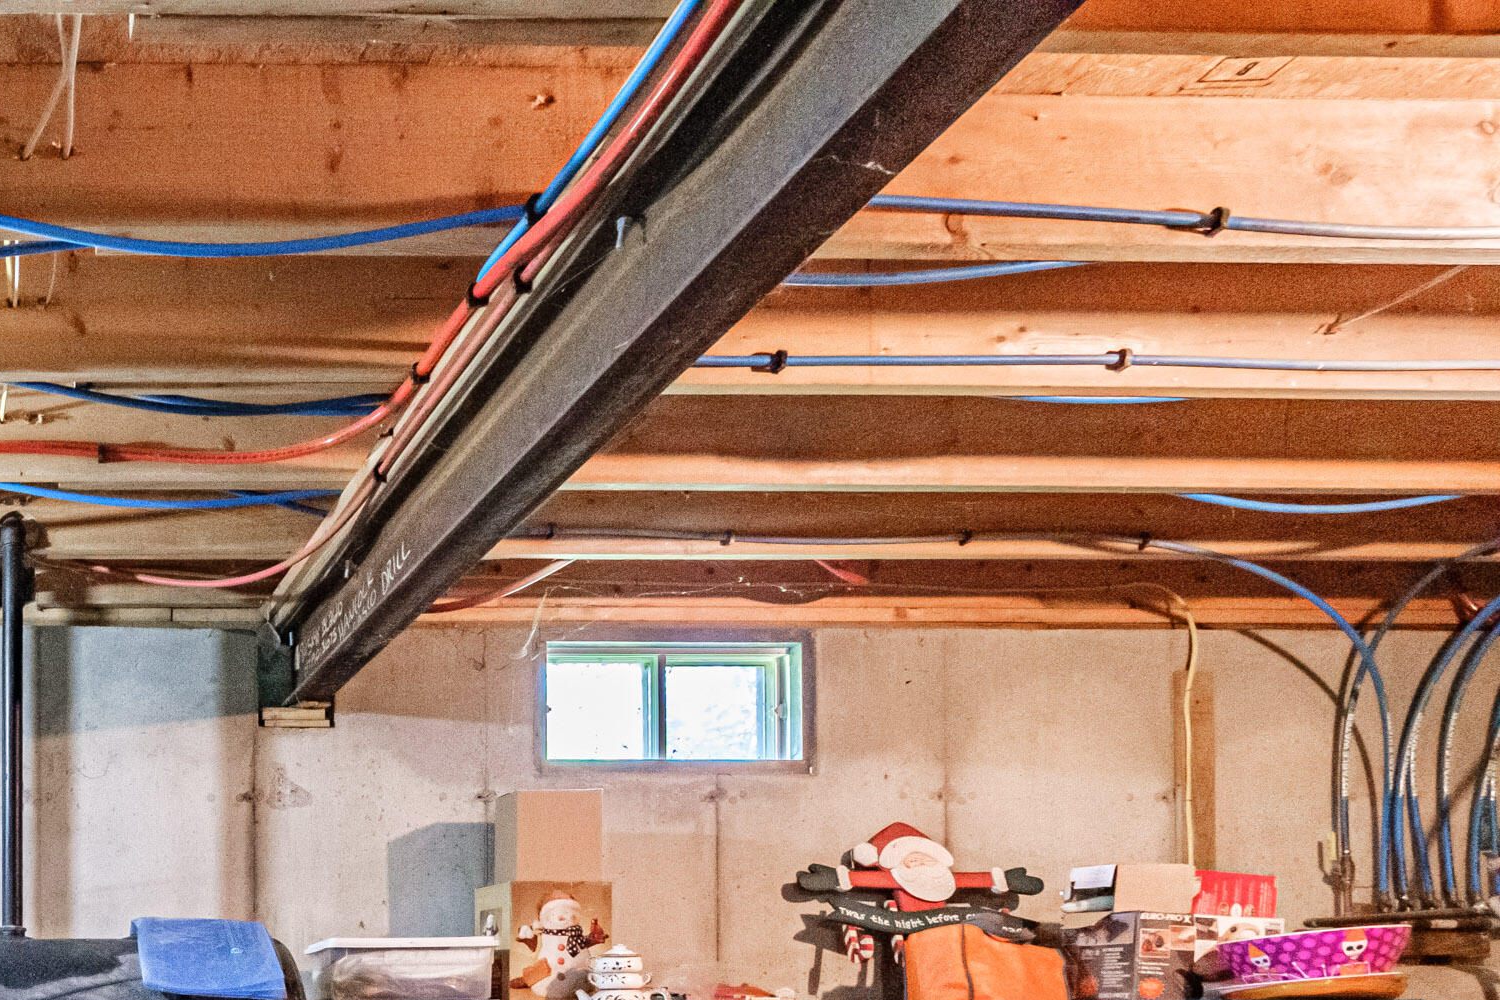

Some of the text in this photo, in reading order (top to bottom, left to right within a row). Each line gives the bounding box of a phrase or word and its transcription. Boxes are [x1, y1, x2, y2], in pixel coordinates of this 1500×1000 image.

[381, 542, 411, 595] DRILL
[870, 914, 890, 926] the
[895, 919, 925, 930] night
[926, 914, 960, 924] before
